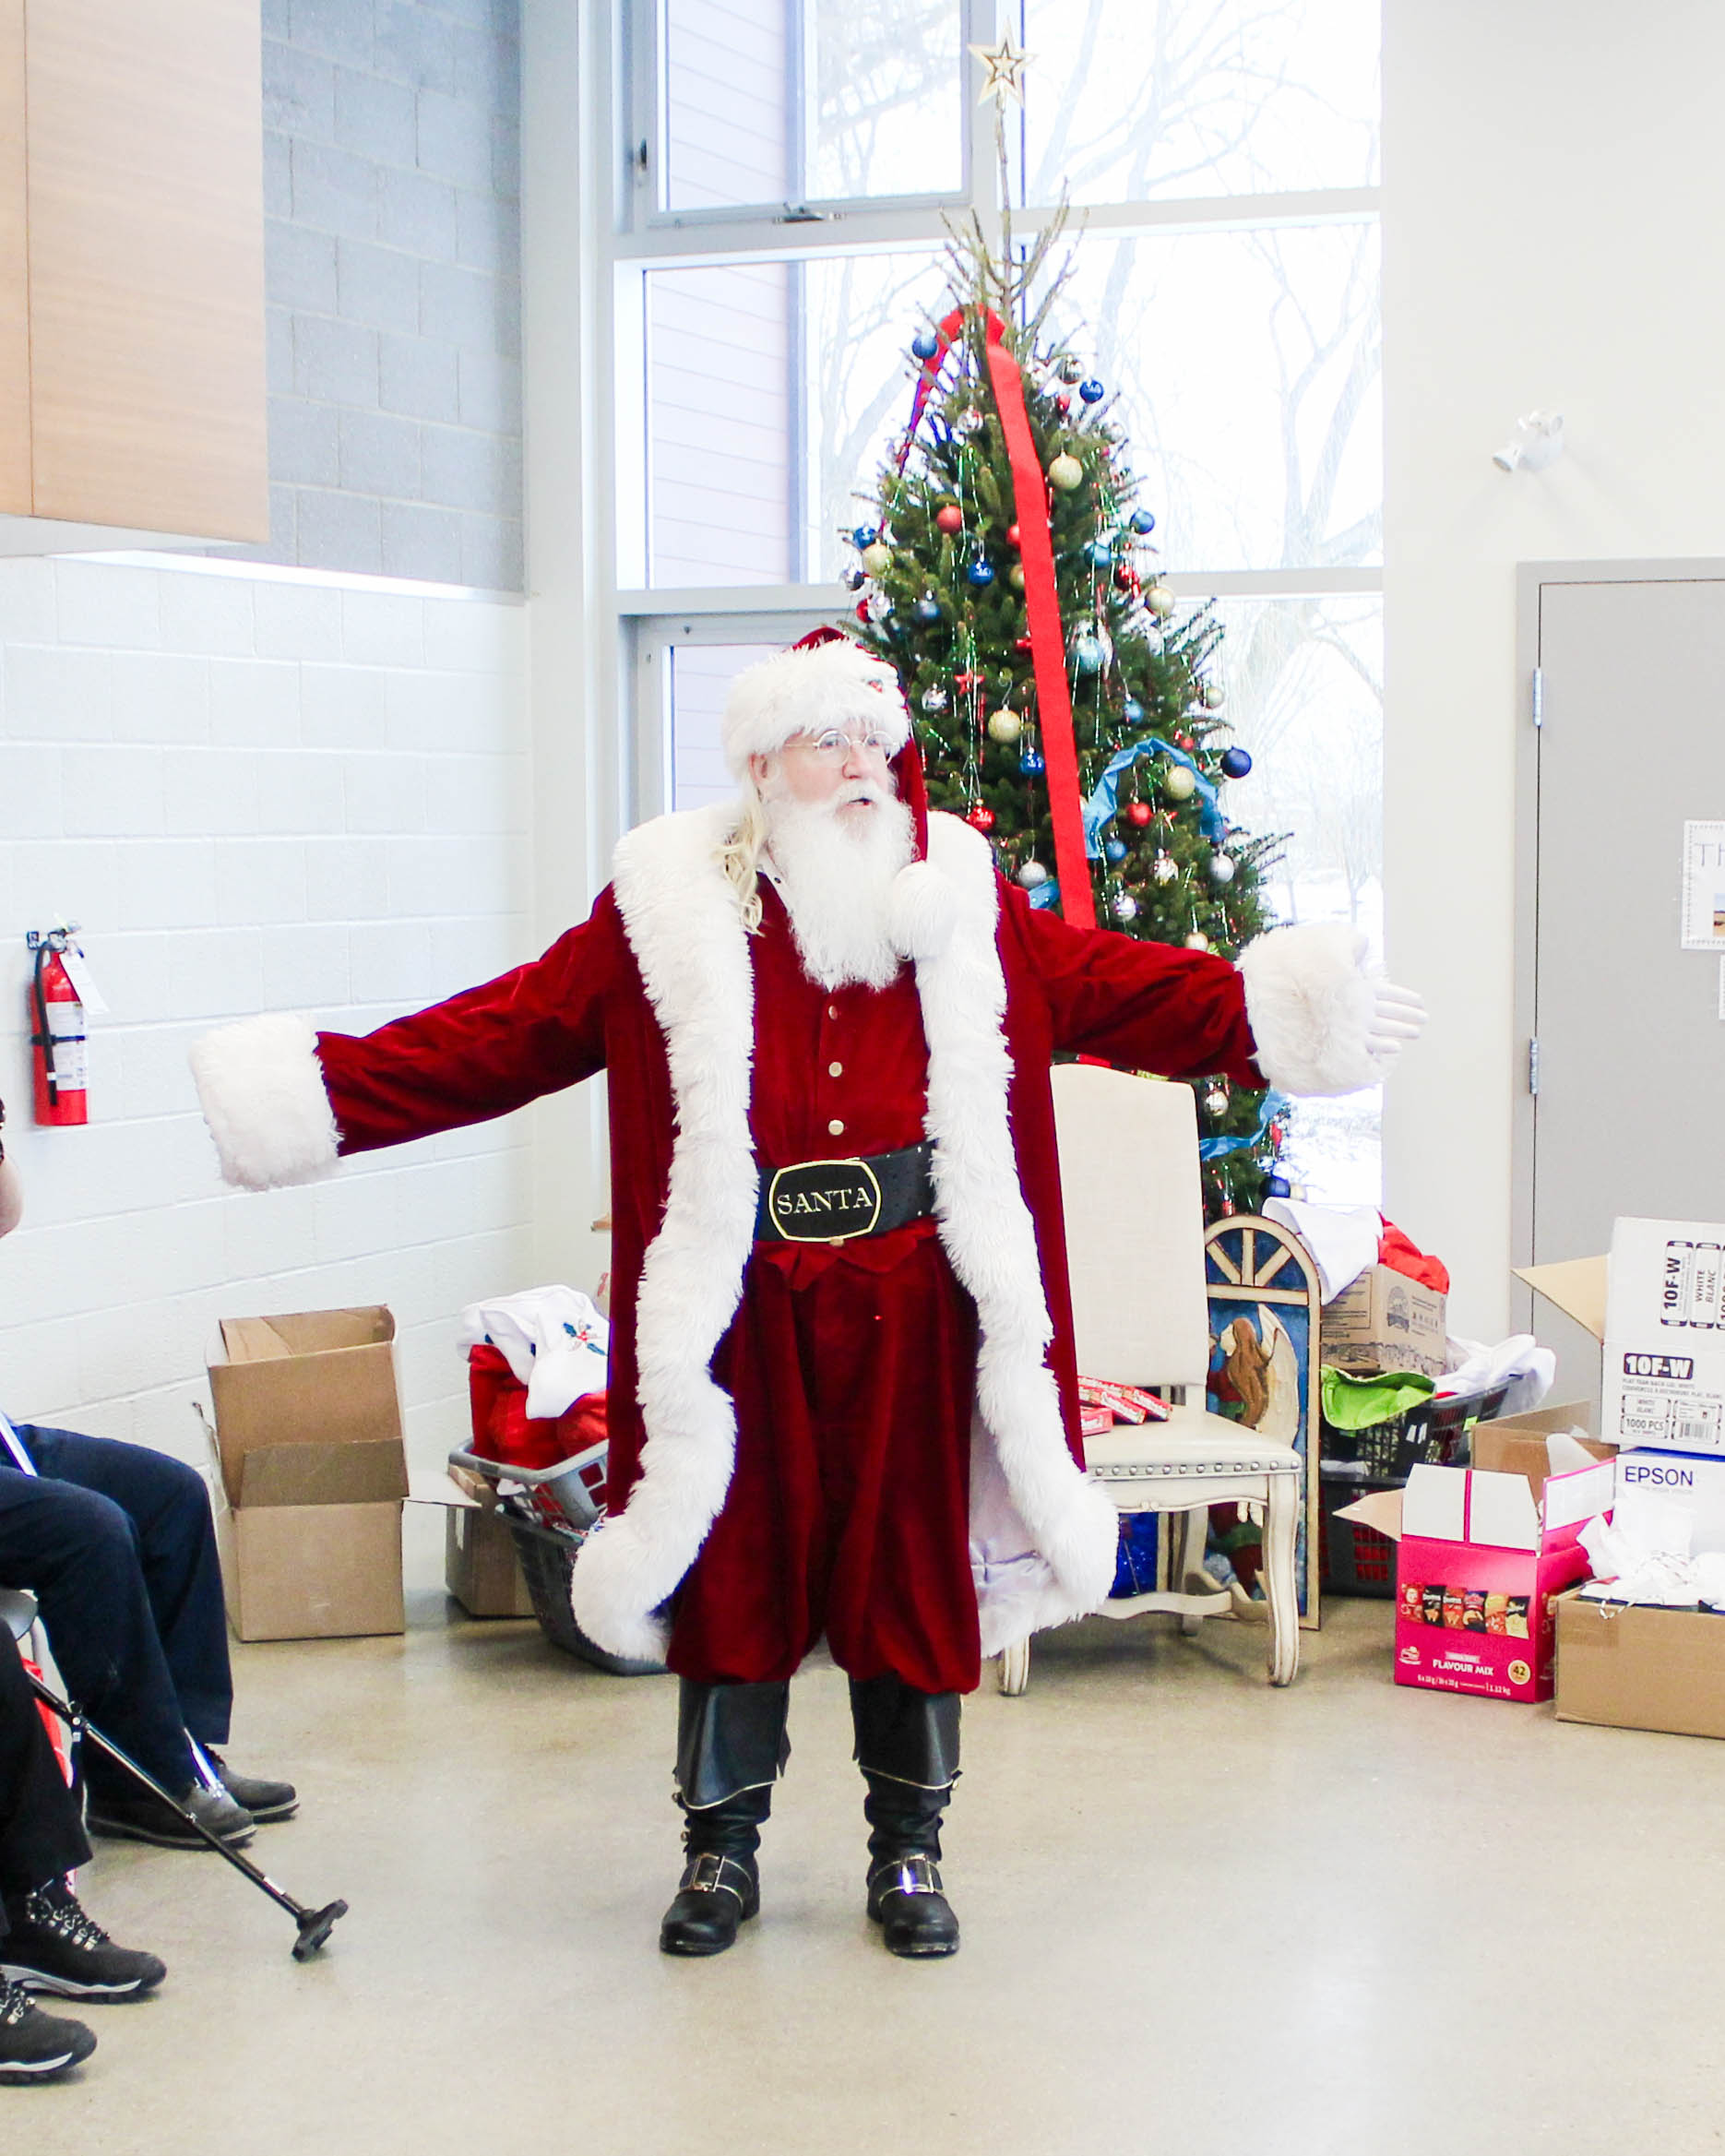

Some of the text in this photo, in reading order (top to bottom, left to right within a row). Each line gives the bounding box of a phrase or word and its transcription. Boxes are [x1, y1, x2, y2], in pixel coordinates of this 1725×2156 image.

[777, 1187, 874, 1216] SANTA
[1663, 1257, 1681, 1310] 10F-W
[1695, 1269, 1705, 1302] WHITE
[1705, 1269, 1717, 1304] BLANC
[1625, 1354, 1692, 1378] 10F-W
[1626, 1418, 1664, 1432] 1000 PCS
[1624, 1466, 1694, 1486] EPSON
[1432, 1659, 1494, 1676] FLAVOUR MIX
[1513, 1664, 1526, 1676] 42
